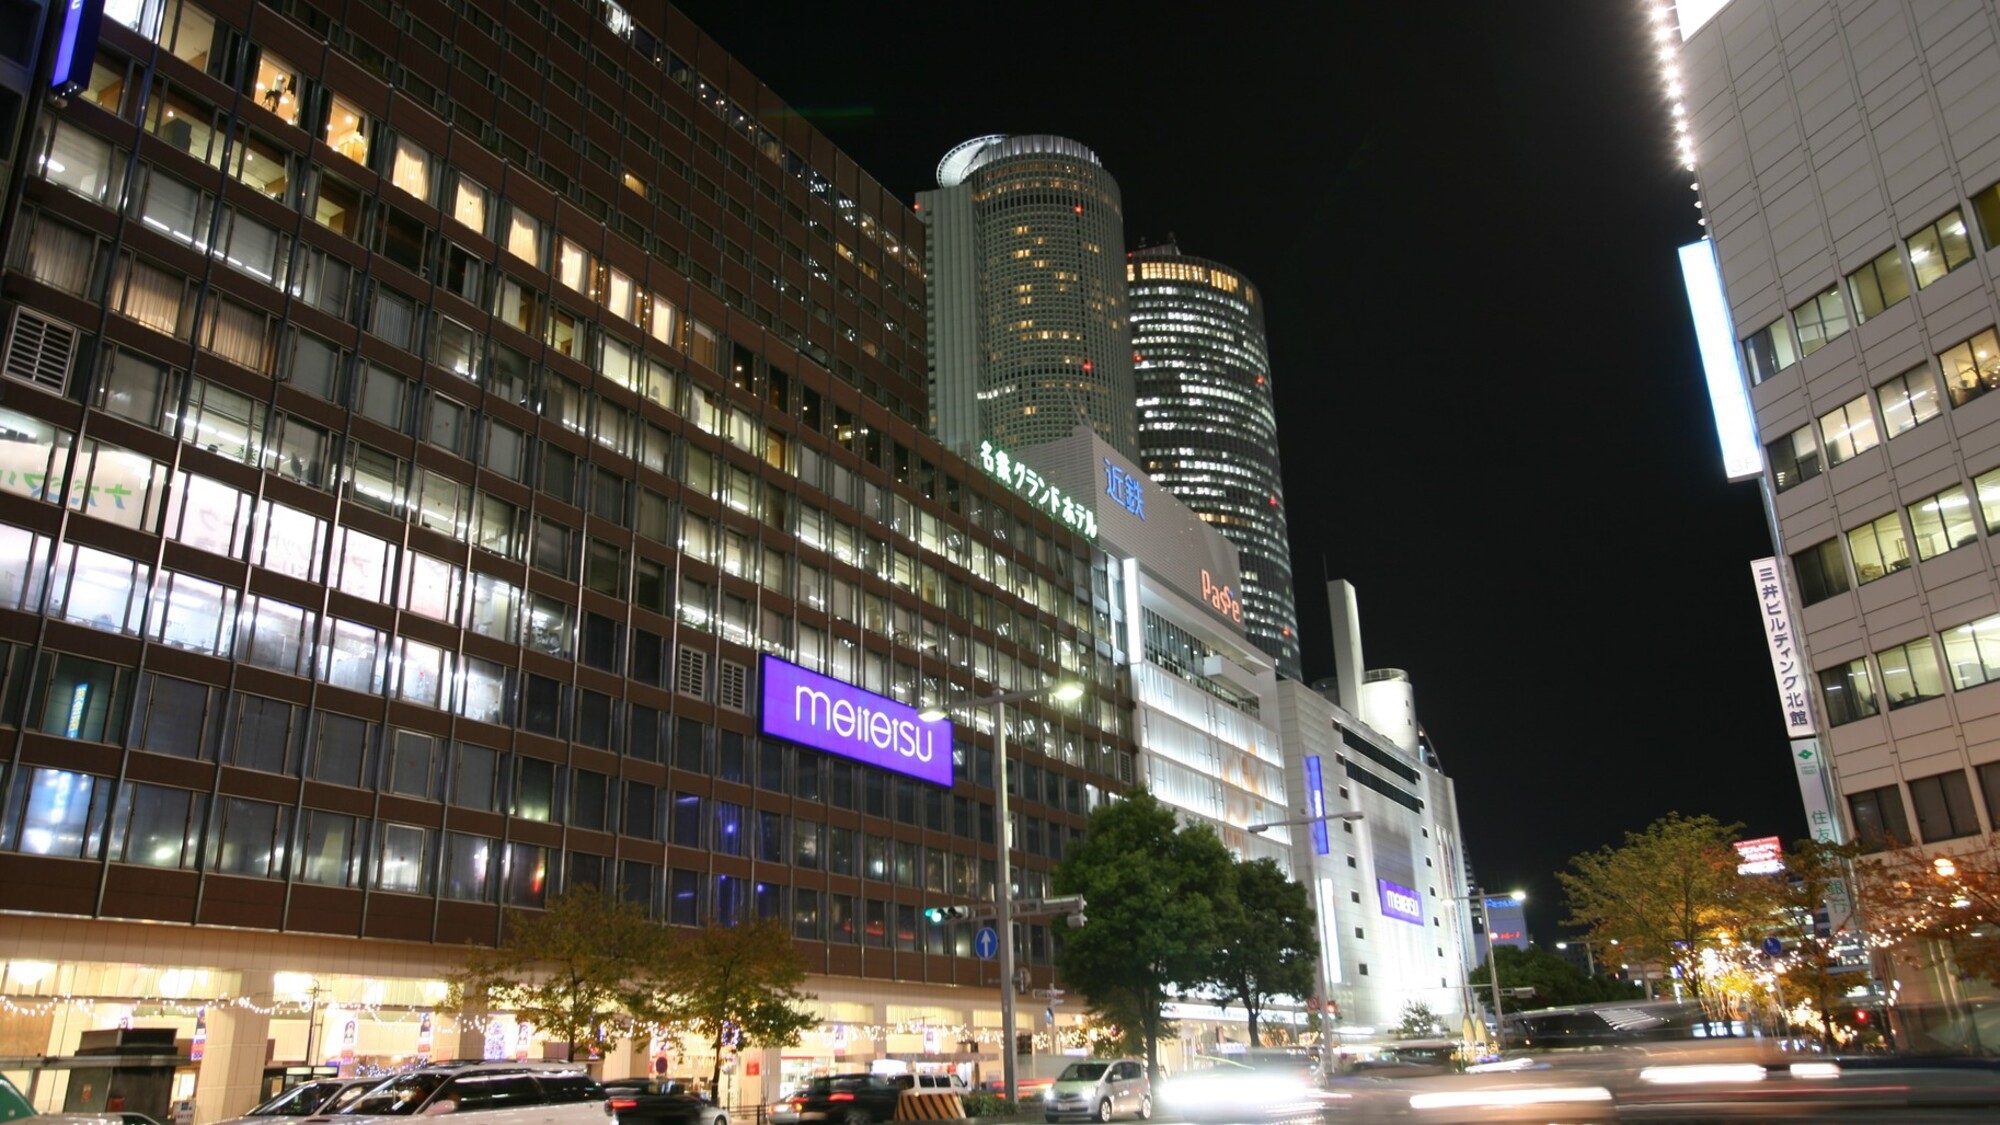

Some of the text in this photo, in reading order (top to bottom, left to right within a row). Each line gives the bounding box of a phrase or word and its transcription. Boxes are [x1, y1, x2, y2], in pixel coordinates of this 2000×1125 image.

[1104, 457, 1146, 521] 近鉄
[1758, 567, 1808, 727] 三井ビルディング北館
[795, 684, 933, 762] meitetsu
